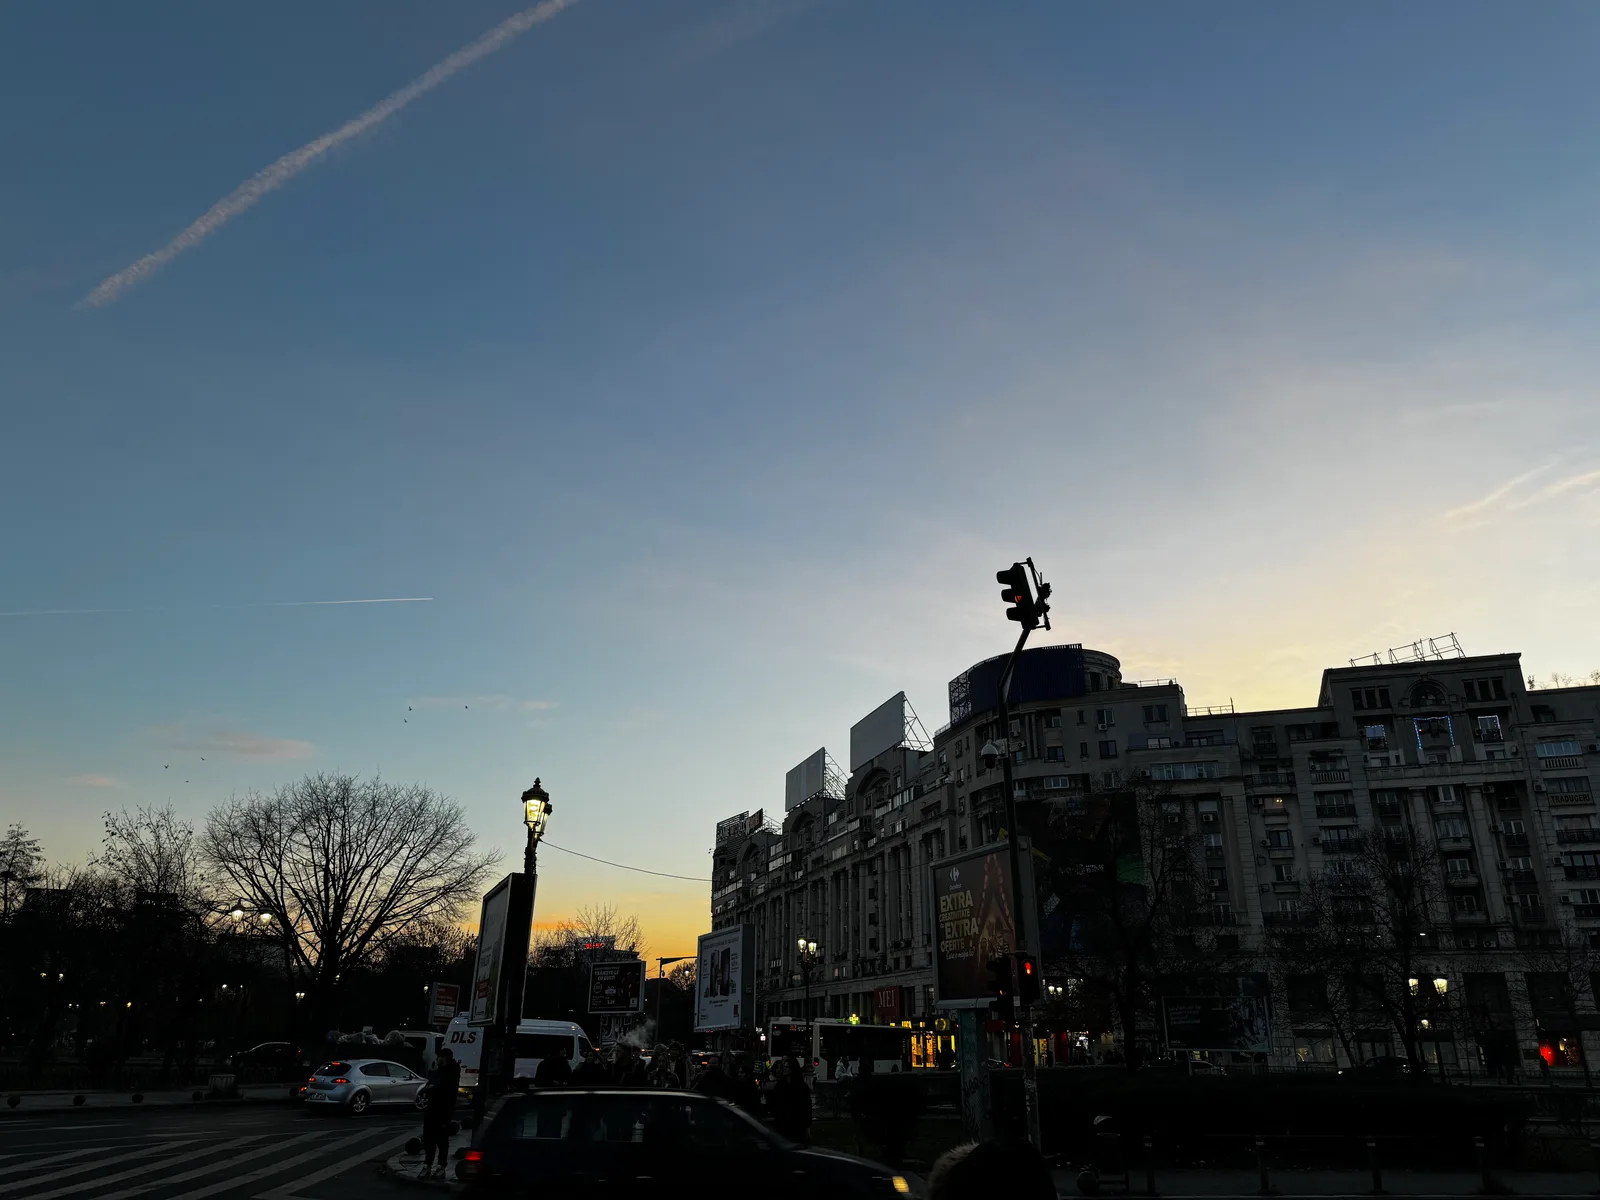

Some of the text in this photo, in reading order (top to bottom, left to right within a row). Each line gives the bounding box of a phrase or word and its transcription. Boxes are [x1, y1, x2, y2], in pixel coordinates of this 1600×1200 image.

[1550, 794, 1591, 803] TRADUCERI
[940, 889, 974, 913] EXTRA
[939, 908, 971, 922] CREATIVITATE
[945, 917, 979, 940] EXTRA
[940, 938, 965, 953] OFERTE
[450, 1031, 477, 1044] DLS
